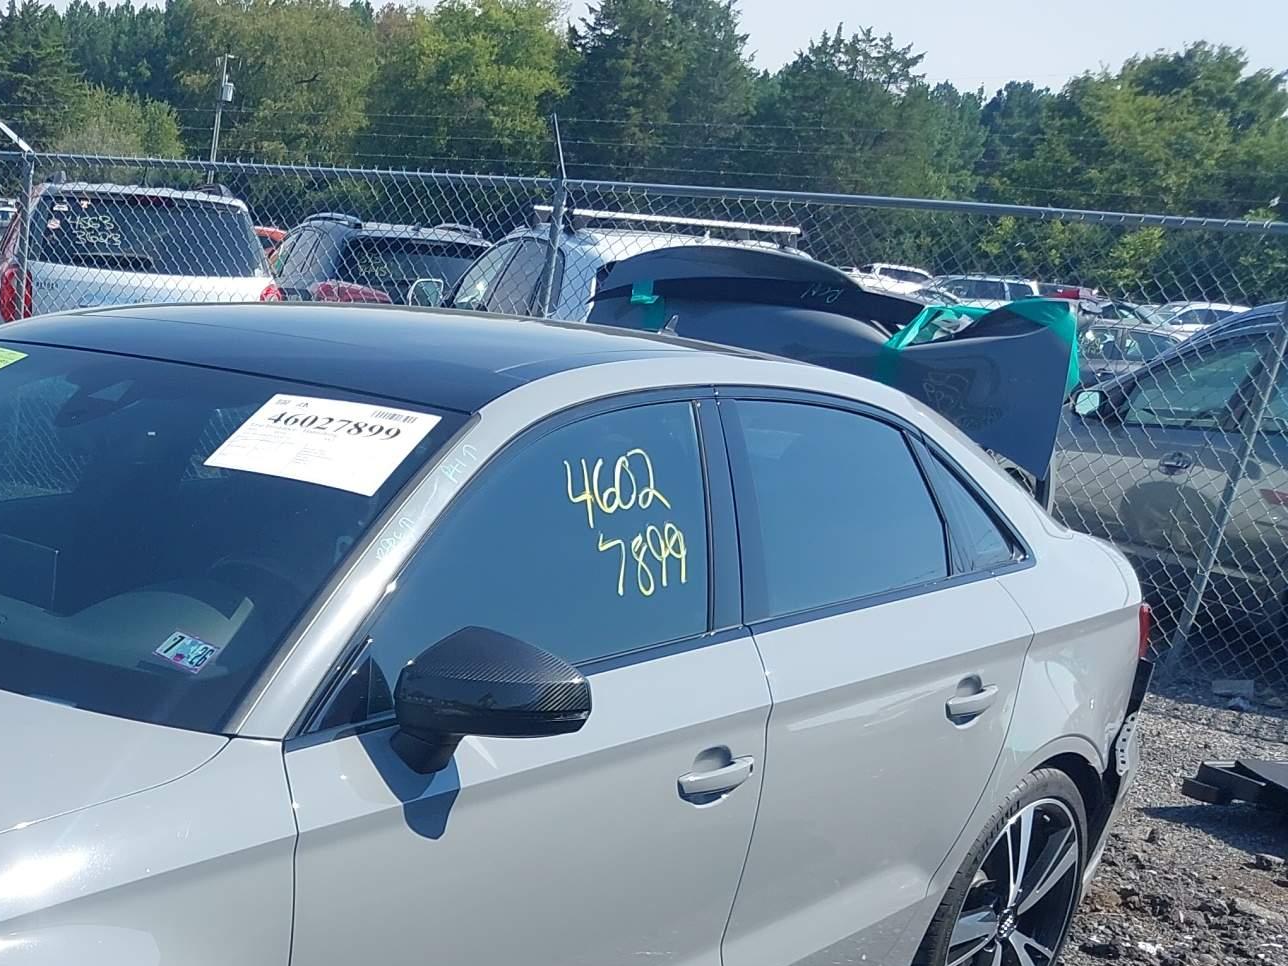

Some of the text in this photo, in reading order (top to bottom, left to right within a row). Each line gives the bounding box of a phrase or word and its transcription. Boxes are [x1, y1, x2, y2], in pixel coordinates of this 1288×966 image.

[267, 411, 402, 441] 46027899
[563, 448, 672, 529] 4602
[598, 522, 688, 596] 7899
[163, 635, 215, 668] 7 26
